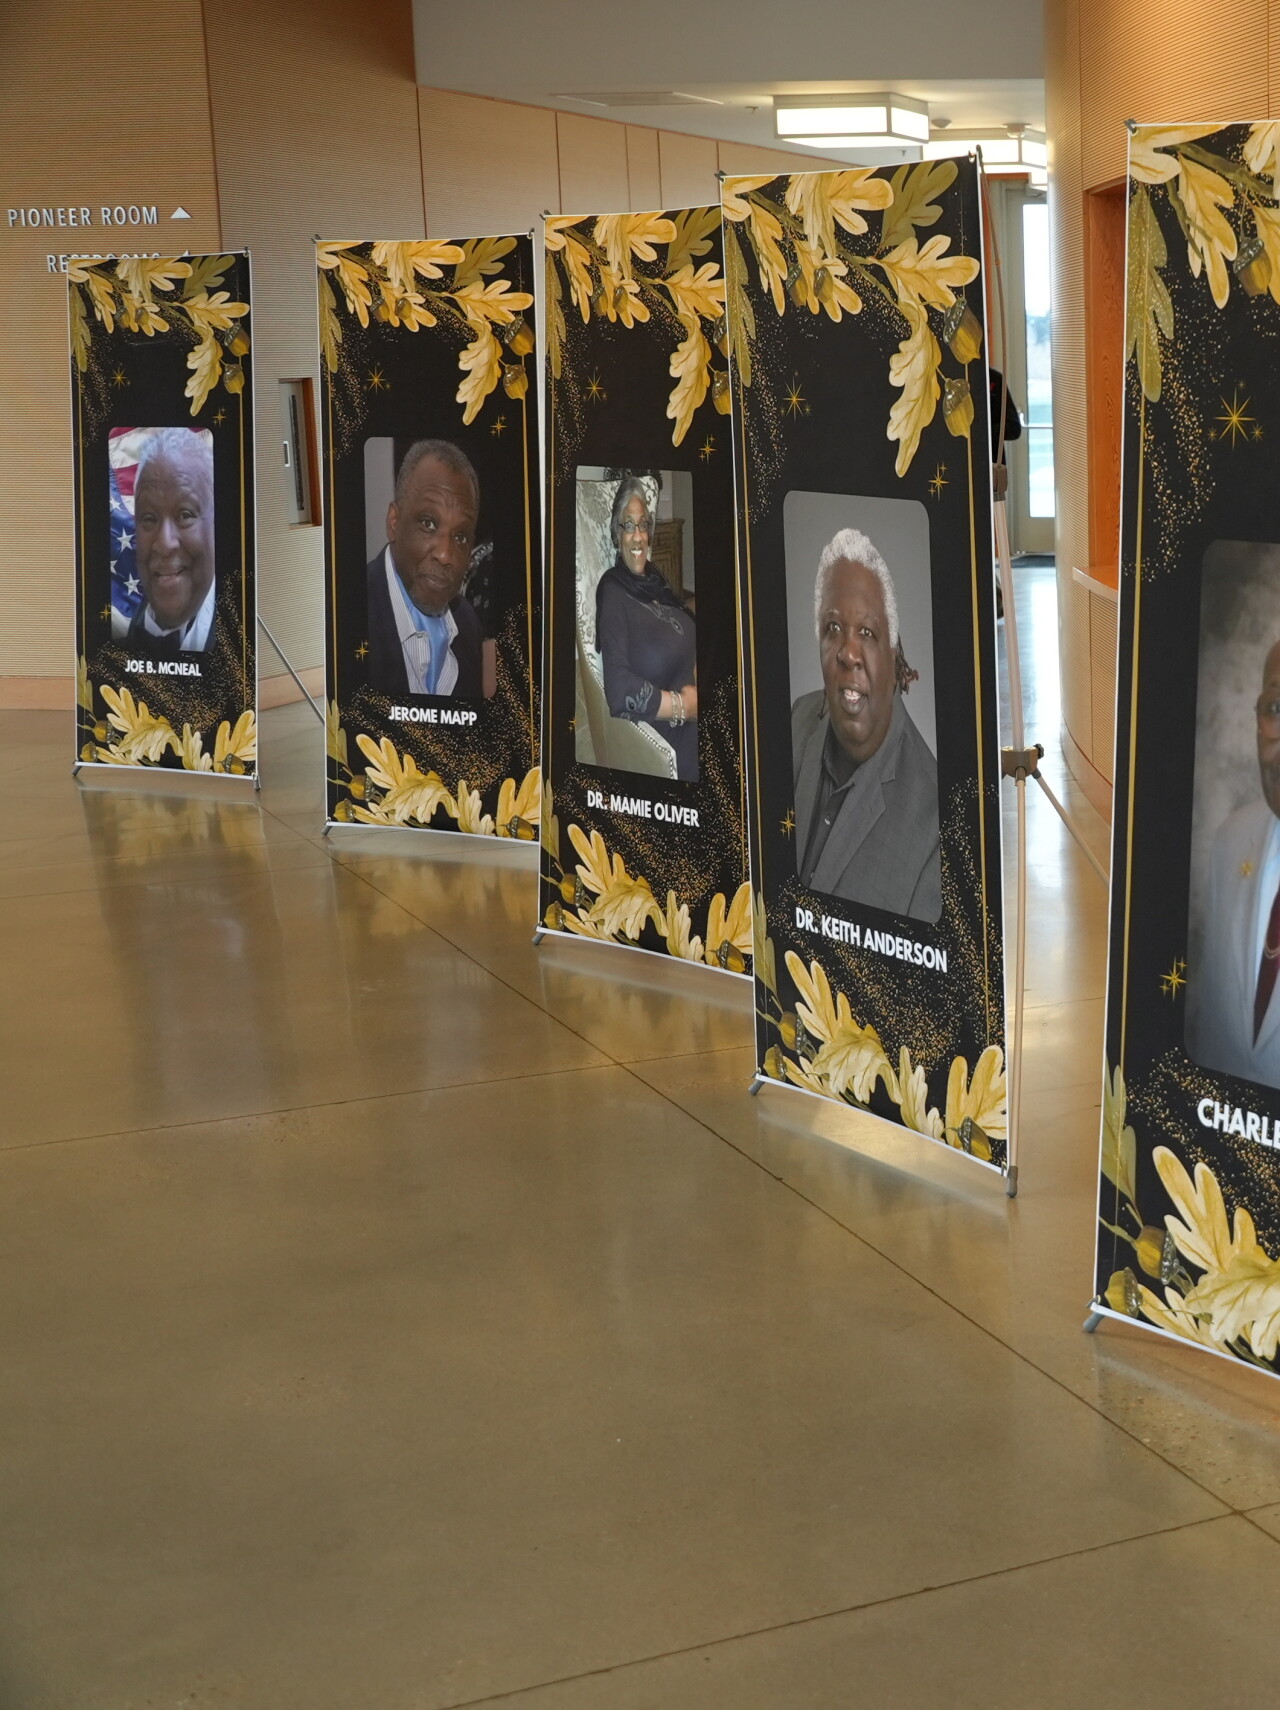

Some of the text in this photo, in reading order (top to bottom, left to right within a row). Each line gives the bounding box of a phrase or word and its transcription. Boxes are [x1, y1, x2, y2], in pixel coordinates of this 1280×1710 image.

[8, 206, 158, 227] PIONEER ROOM
[125, 660, 202, 676] JOE B. MCNEAL
[388, 706, 477, 726] JEROME MAPP
[587, 790, 700, 828] DR. MAMIE OLIVER
[795, 906, 948, 973] DR. KEITH ANDERSON
